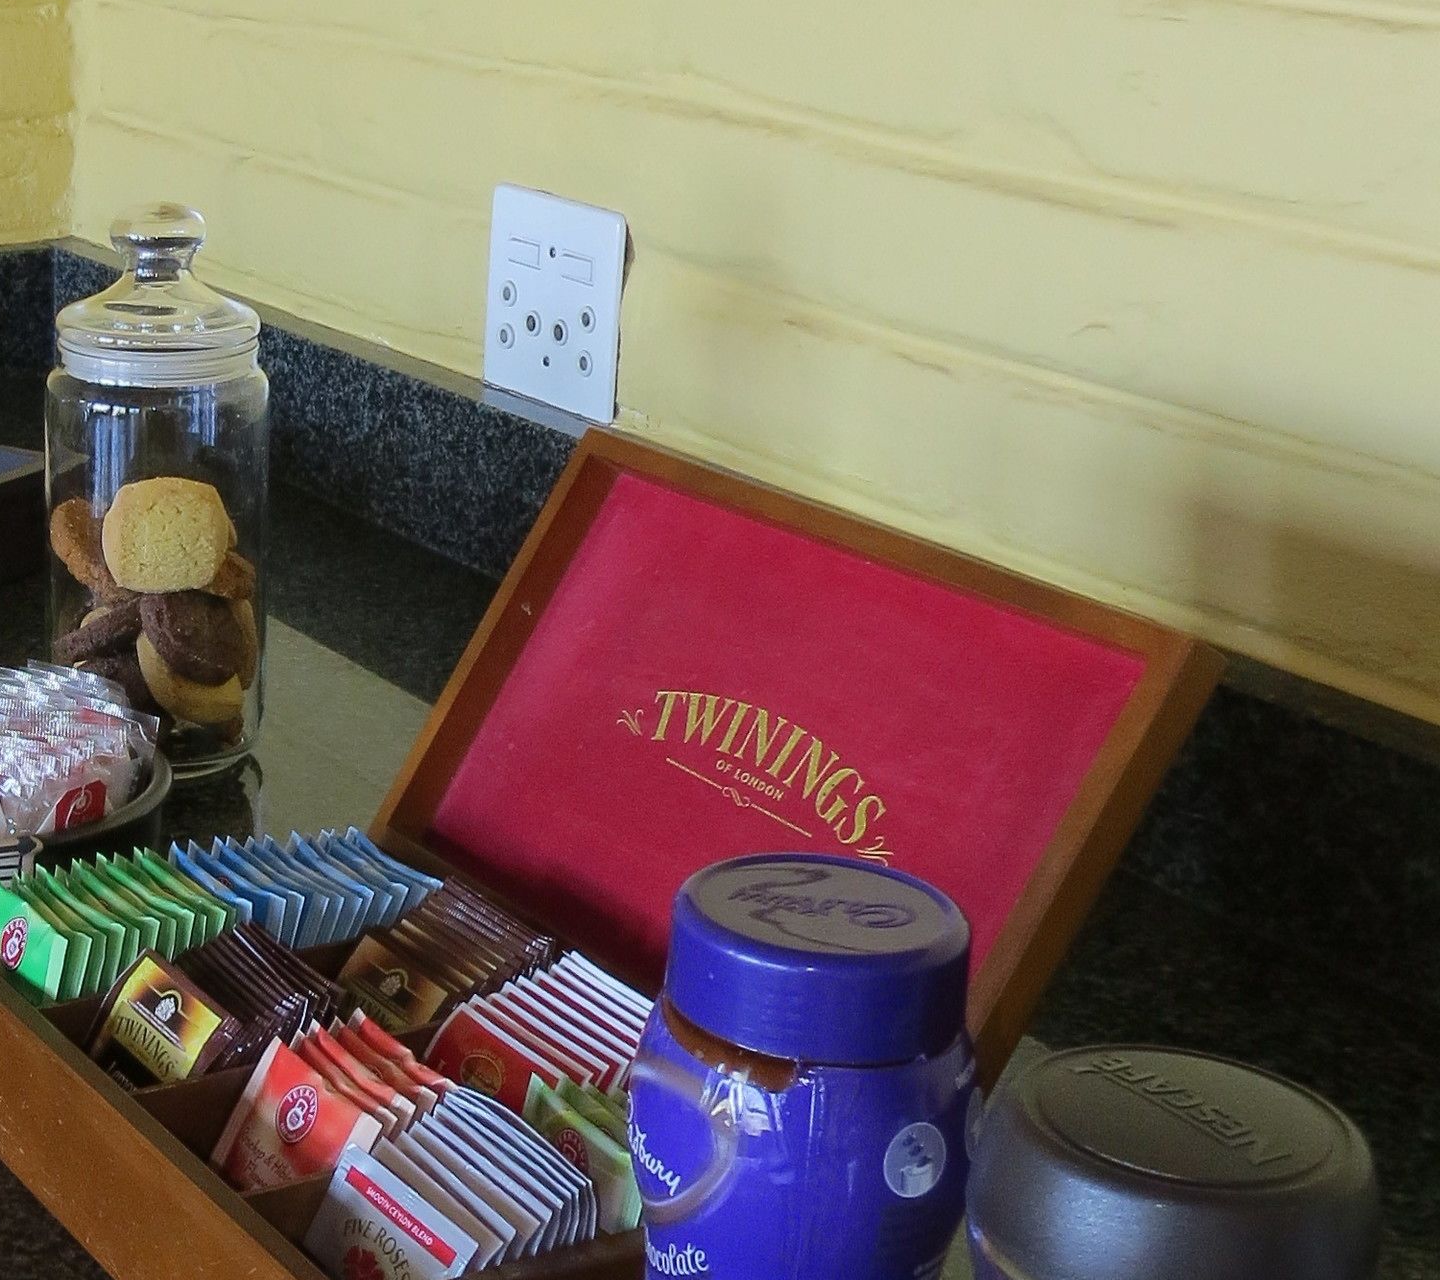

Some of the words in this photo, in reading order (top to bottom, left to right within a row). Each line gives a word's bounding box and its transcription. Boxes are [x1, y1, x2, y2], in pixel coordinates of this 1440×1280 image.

[651, 689, 887, 845] TWININGS
[715, 759, 732, 773] OF
[733, 769, 785, 802] LONDON
[113, 1016, 179, 1078] TWININGS
[365, 1186, 391, 1210] SMOOTH
[343, 1219, 375, 1239] FIVE
